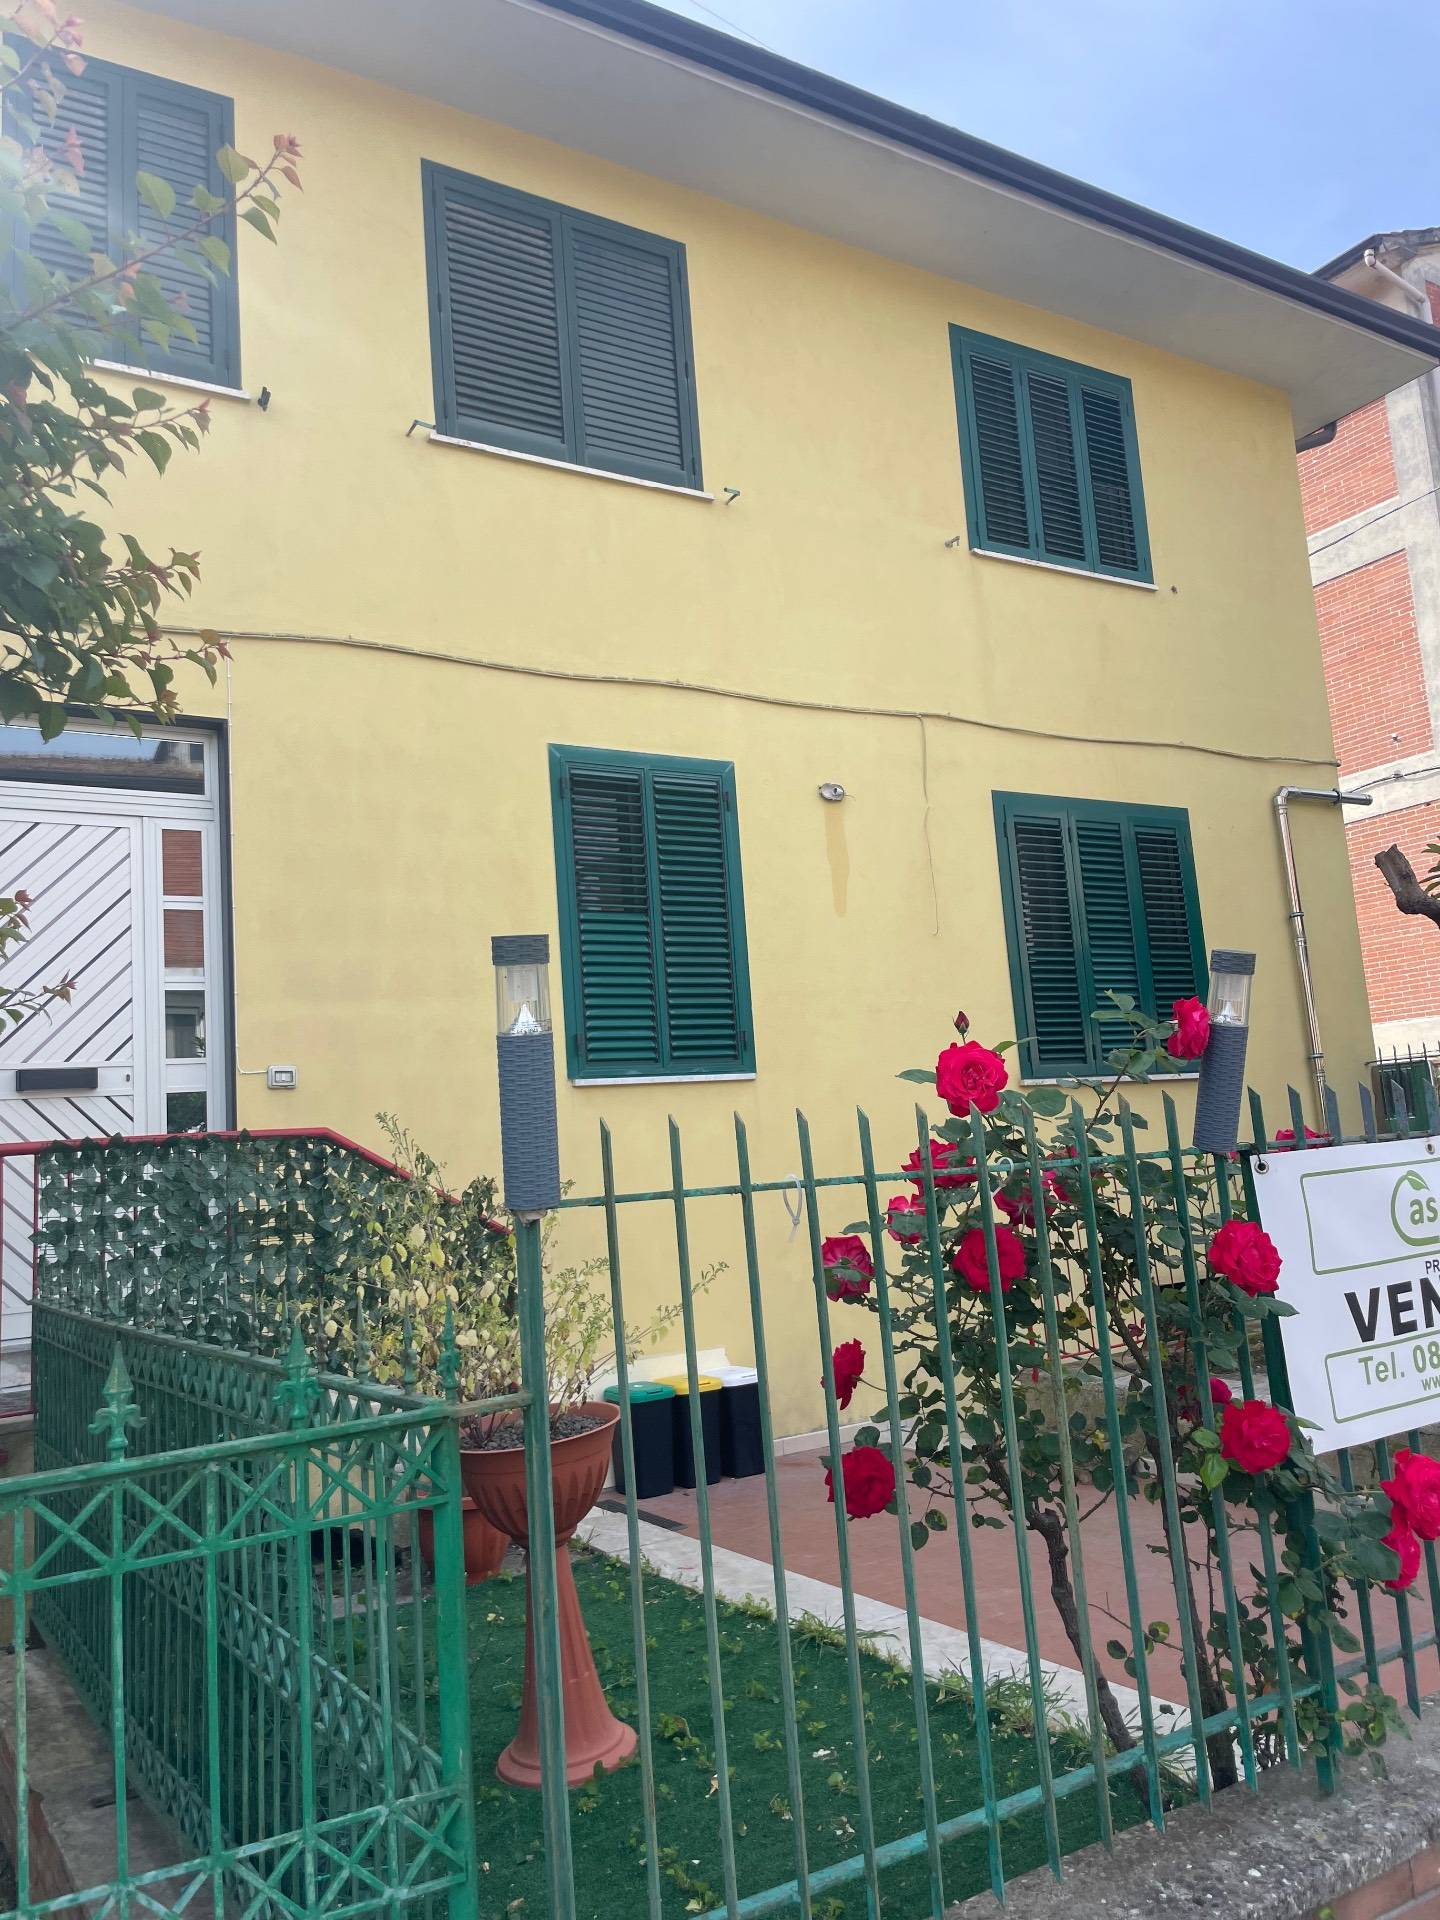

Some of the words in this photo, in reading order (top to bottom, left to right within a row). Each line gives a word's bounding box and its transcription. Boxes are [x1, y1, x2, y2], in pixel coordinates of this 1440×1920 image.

[1410, 1197, 1438, 1225] as
[1425, 1259, 1440, 1274] PR
[1358, 1352, 1405, 1384] Tel.
[1413, 1341, 1440, 1373] 08
